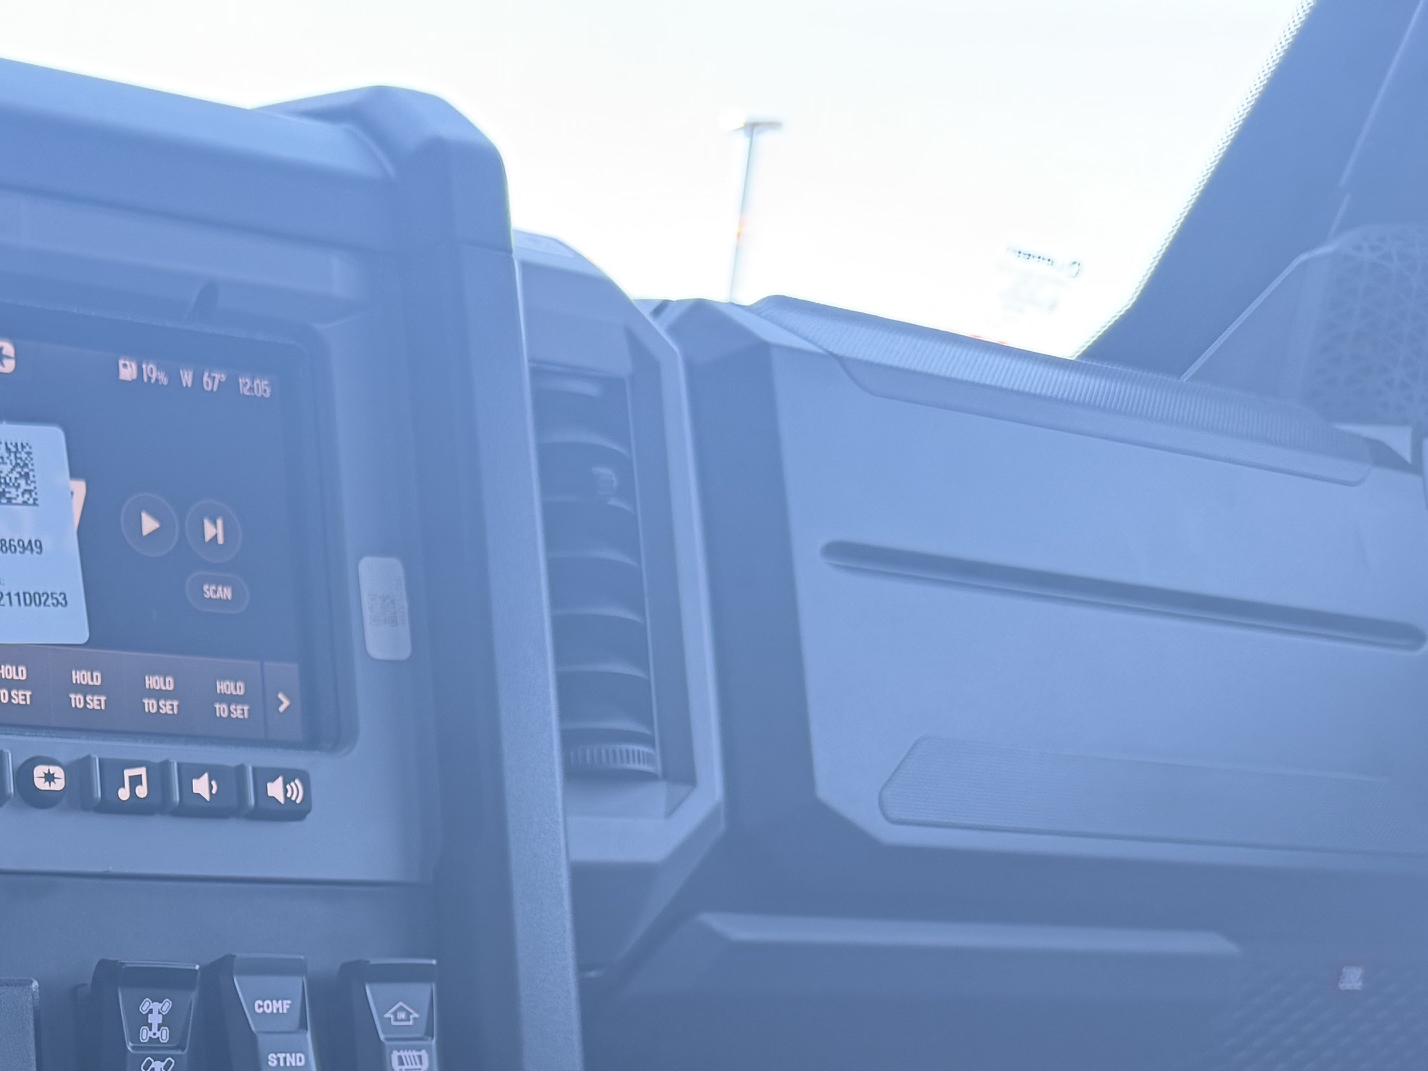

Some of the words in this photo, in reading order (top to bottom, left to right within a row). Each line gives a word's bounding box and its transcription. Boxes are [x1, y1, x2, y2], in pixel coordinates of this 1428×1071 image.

[142, 362, 169, 385] 19%
[180, 368, 193, 387] W
[238, 377, 271, 398] 12:05
[202, 583, 232, 600] SCAN
[72, 669, 102, 686] HOLD
[145, 675, 174, 691] HOLD
[216, 680, 245, 696] HOLD
[11, 690, 32, 705] SET
[69, 693, 85, 709] TO
[86, 695, 107, 710] SET
[142, 698, 157, 714] TO
[158, 699, 179, 715] SET
[214, 703, 229, 718] TO
[230, 704, 250, 720] SET
[254, 999, 292, 1014] COMF
[267, 1053, 306, 1068] STND
